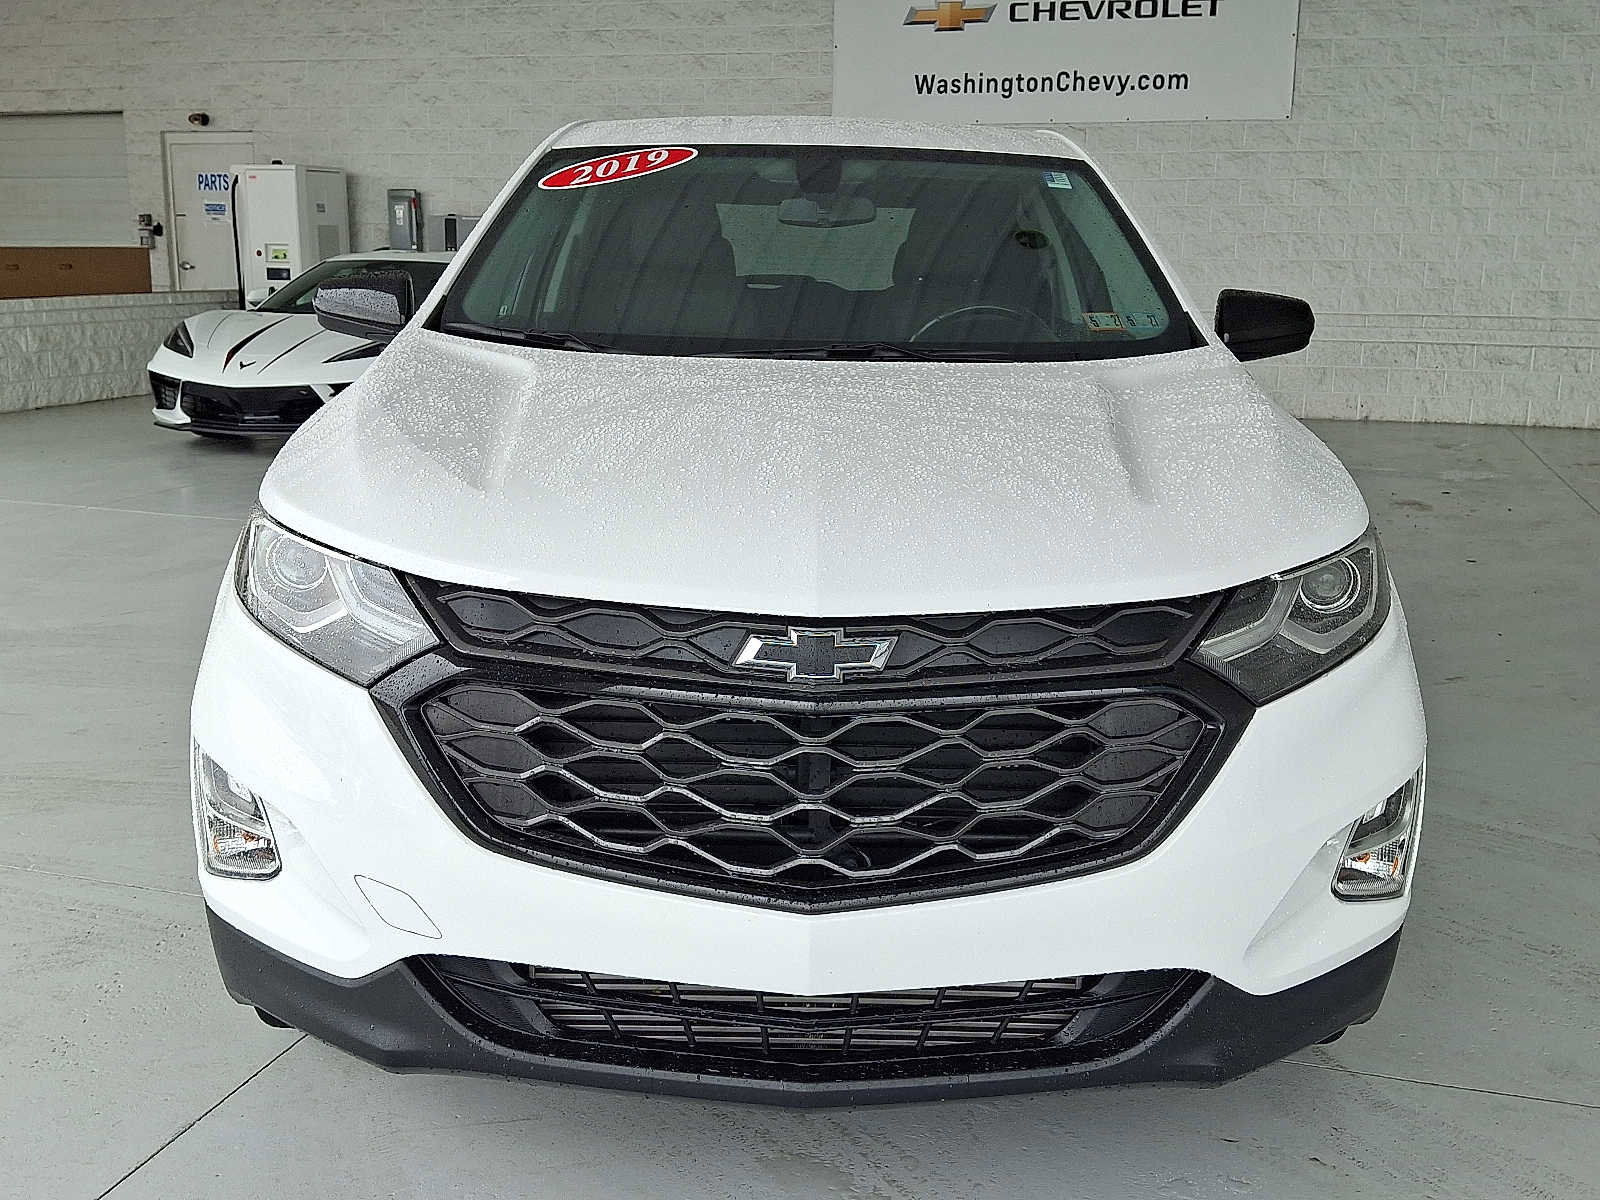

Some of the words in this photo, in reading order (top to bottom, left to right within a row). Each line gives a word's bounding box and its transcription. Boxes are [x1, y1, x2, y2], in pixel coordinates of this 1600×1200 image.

[1009, 0, 1223, 22] CHEVROLET
[915, 71, 1189, 98] WashingtonChevy.com
[569, 150, 669, 185] 2019
[198, 174, 229, 191] PARTS
